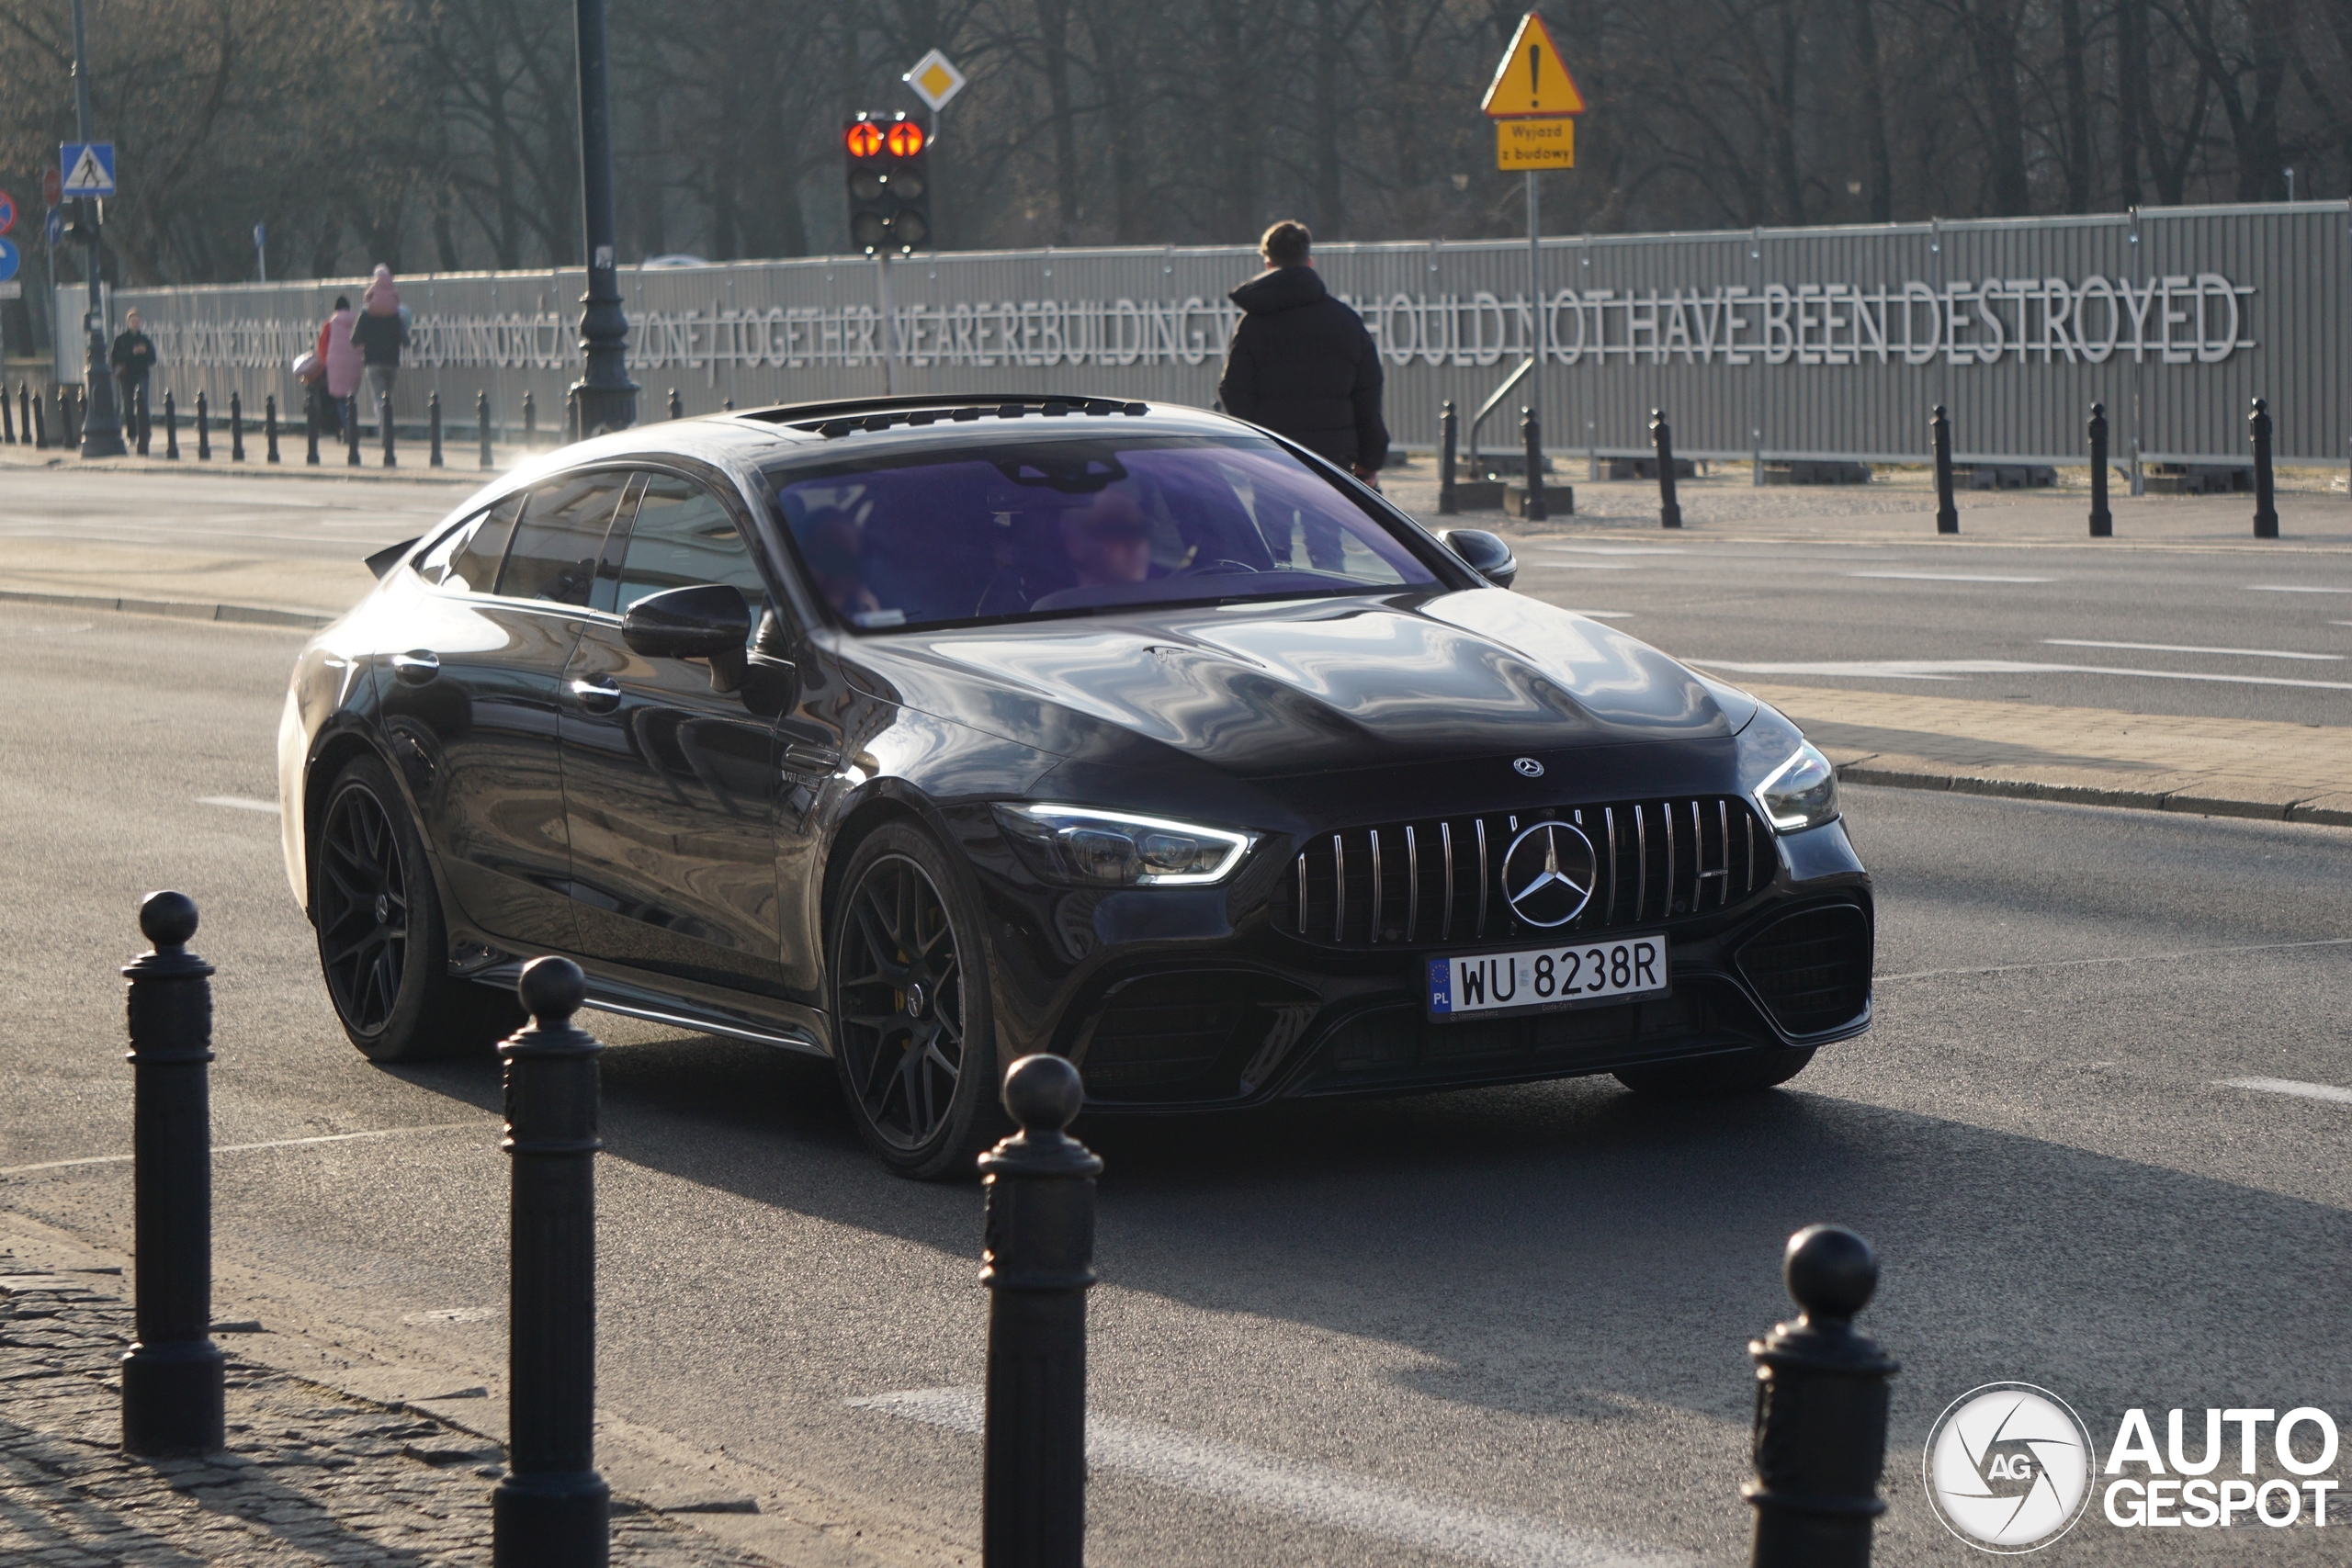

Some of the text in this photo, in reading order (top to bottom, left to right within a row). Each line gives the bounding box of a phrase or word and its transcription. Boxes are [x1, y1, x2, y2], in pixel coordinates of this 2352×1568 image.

[1511, 124, 1562, 141] Wyjazd
[1502, 147, 1569, 163] z budowy
[722, 306, 879, 367] TOGETHER
[934, 302, 994, 367] ARE
[1001, 298, 1207, 367] REBUILDING
[1518, 288, 1615, 366] NOT
[1627, 286, 1751, 366] HAVE
[1764, 283, 1888, 365] BEEN
[1904, 273, 2240, 365] DESTROYED
[1461, 942, 1657, 1006] WU 8238R
[1433, 992, 1449, 1005] PL
